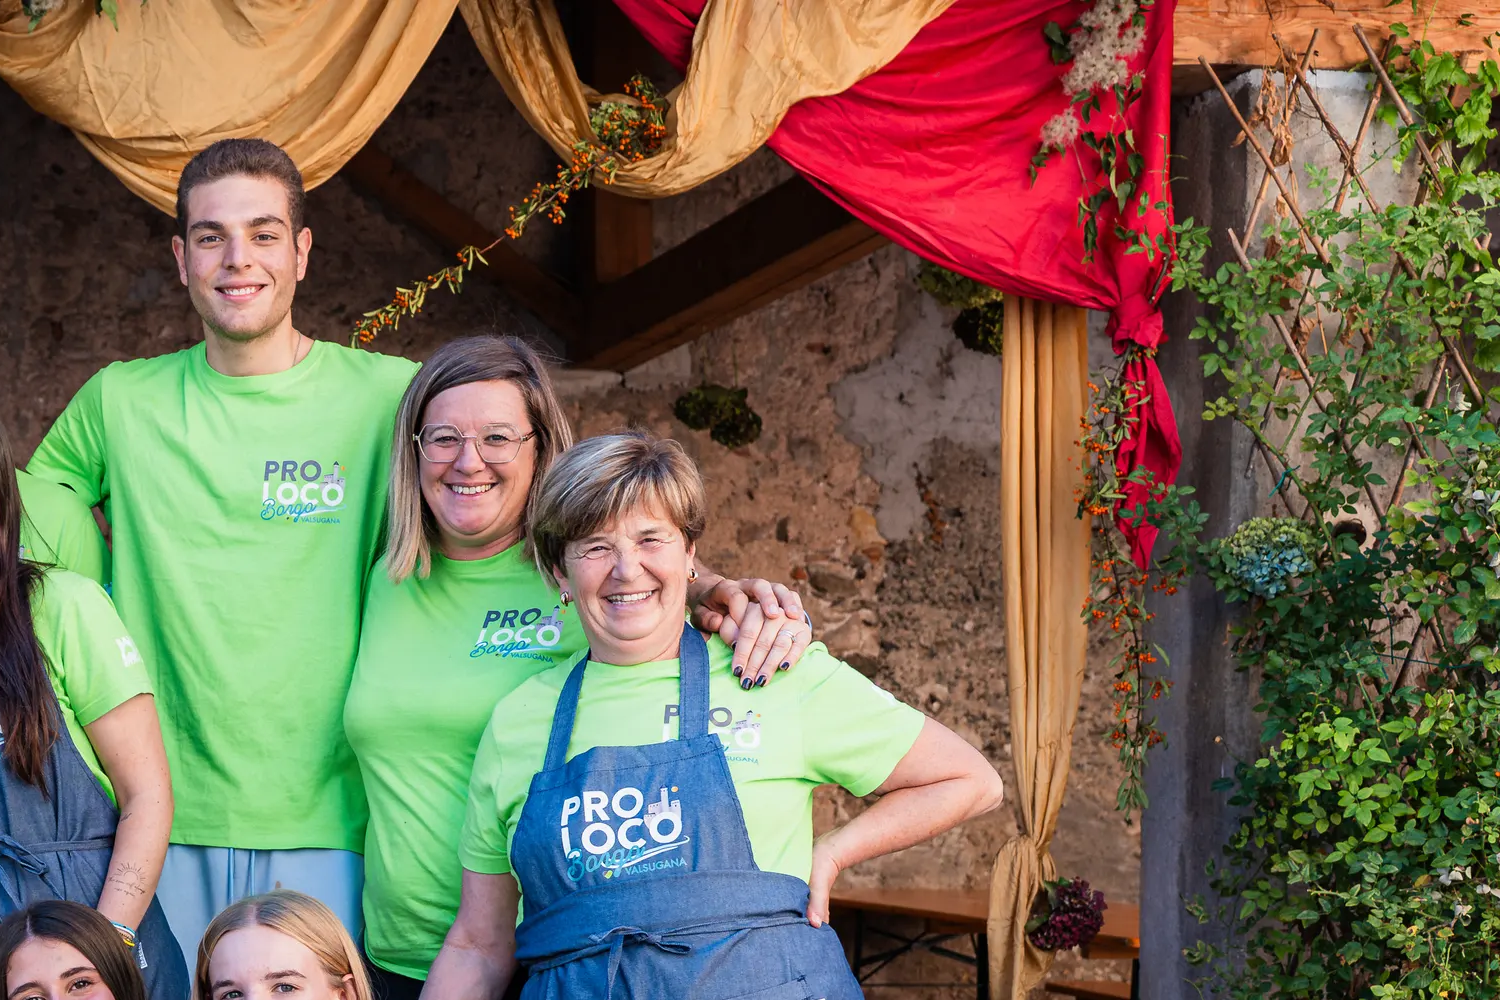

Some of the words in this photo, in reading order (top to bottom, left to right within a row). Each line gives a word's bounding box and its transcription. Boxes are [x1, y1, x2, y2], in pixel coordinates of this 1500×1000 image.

[263, 460, 322, 482] PRO
[262, 482, 344, 507] LOCO
[260, 498, 317, 523] Borgo
[301, 516, 341, 525] VALSUGANA
[482, 607, 542, 629] PRO
[475, 624, 561, 647] LOCO
[469, 639, 531, 658] Borgo
[510, 652, 554, 664] VALSUGANA
[663, 704, 733, 728] PO
[726, 754, 759, 766] SUGANA
[560, 786, 645, 827] PRO
[560, 811, 683, 862] LOCO
[624, 857, 688, 876] VALSUGANA
